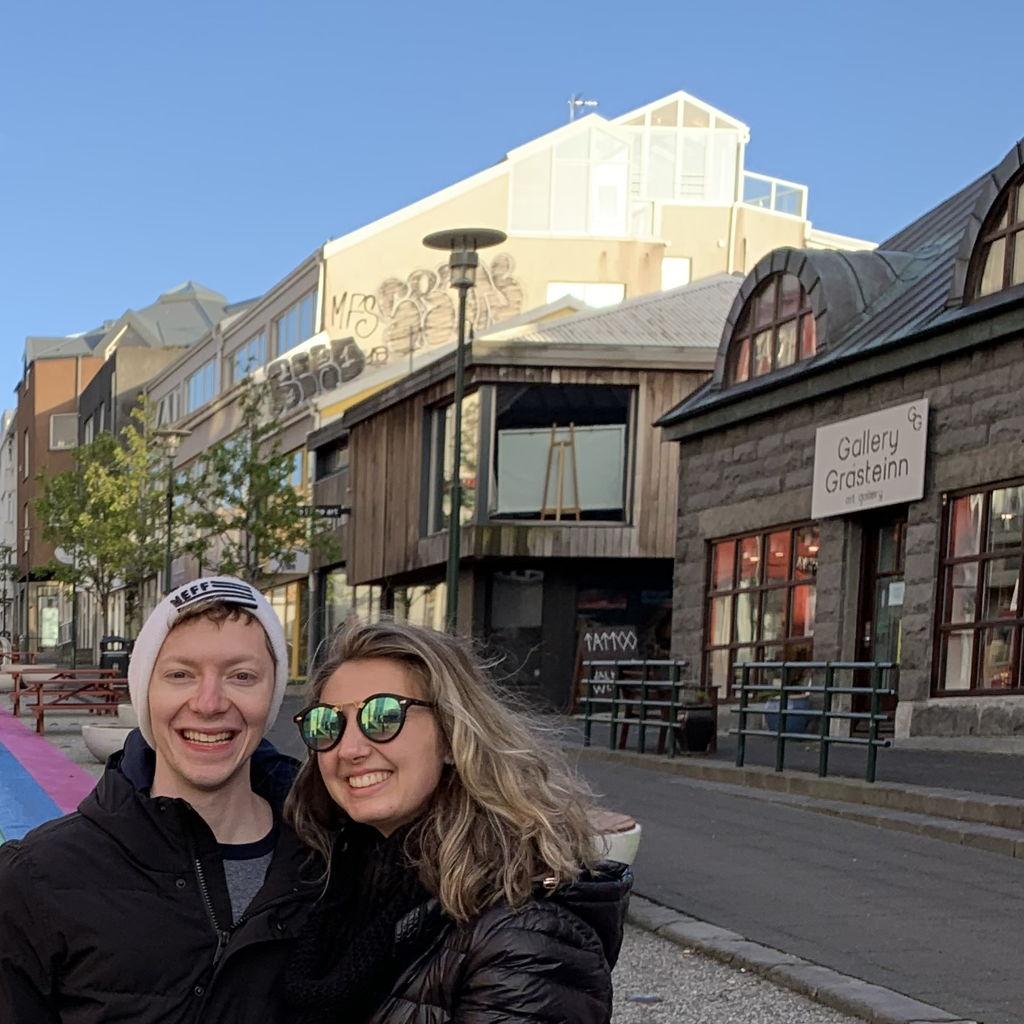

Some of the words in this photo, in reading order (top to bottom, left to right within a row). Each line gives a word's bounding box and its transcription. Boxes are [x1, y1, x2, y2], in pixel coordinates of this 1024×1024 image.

[838, 429, 899, 461] Gallery
[170, 582, 209, 608] NEFF
[584, 631, 638, 651] TATTOO
